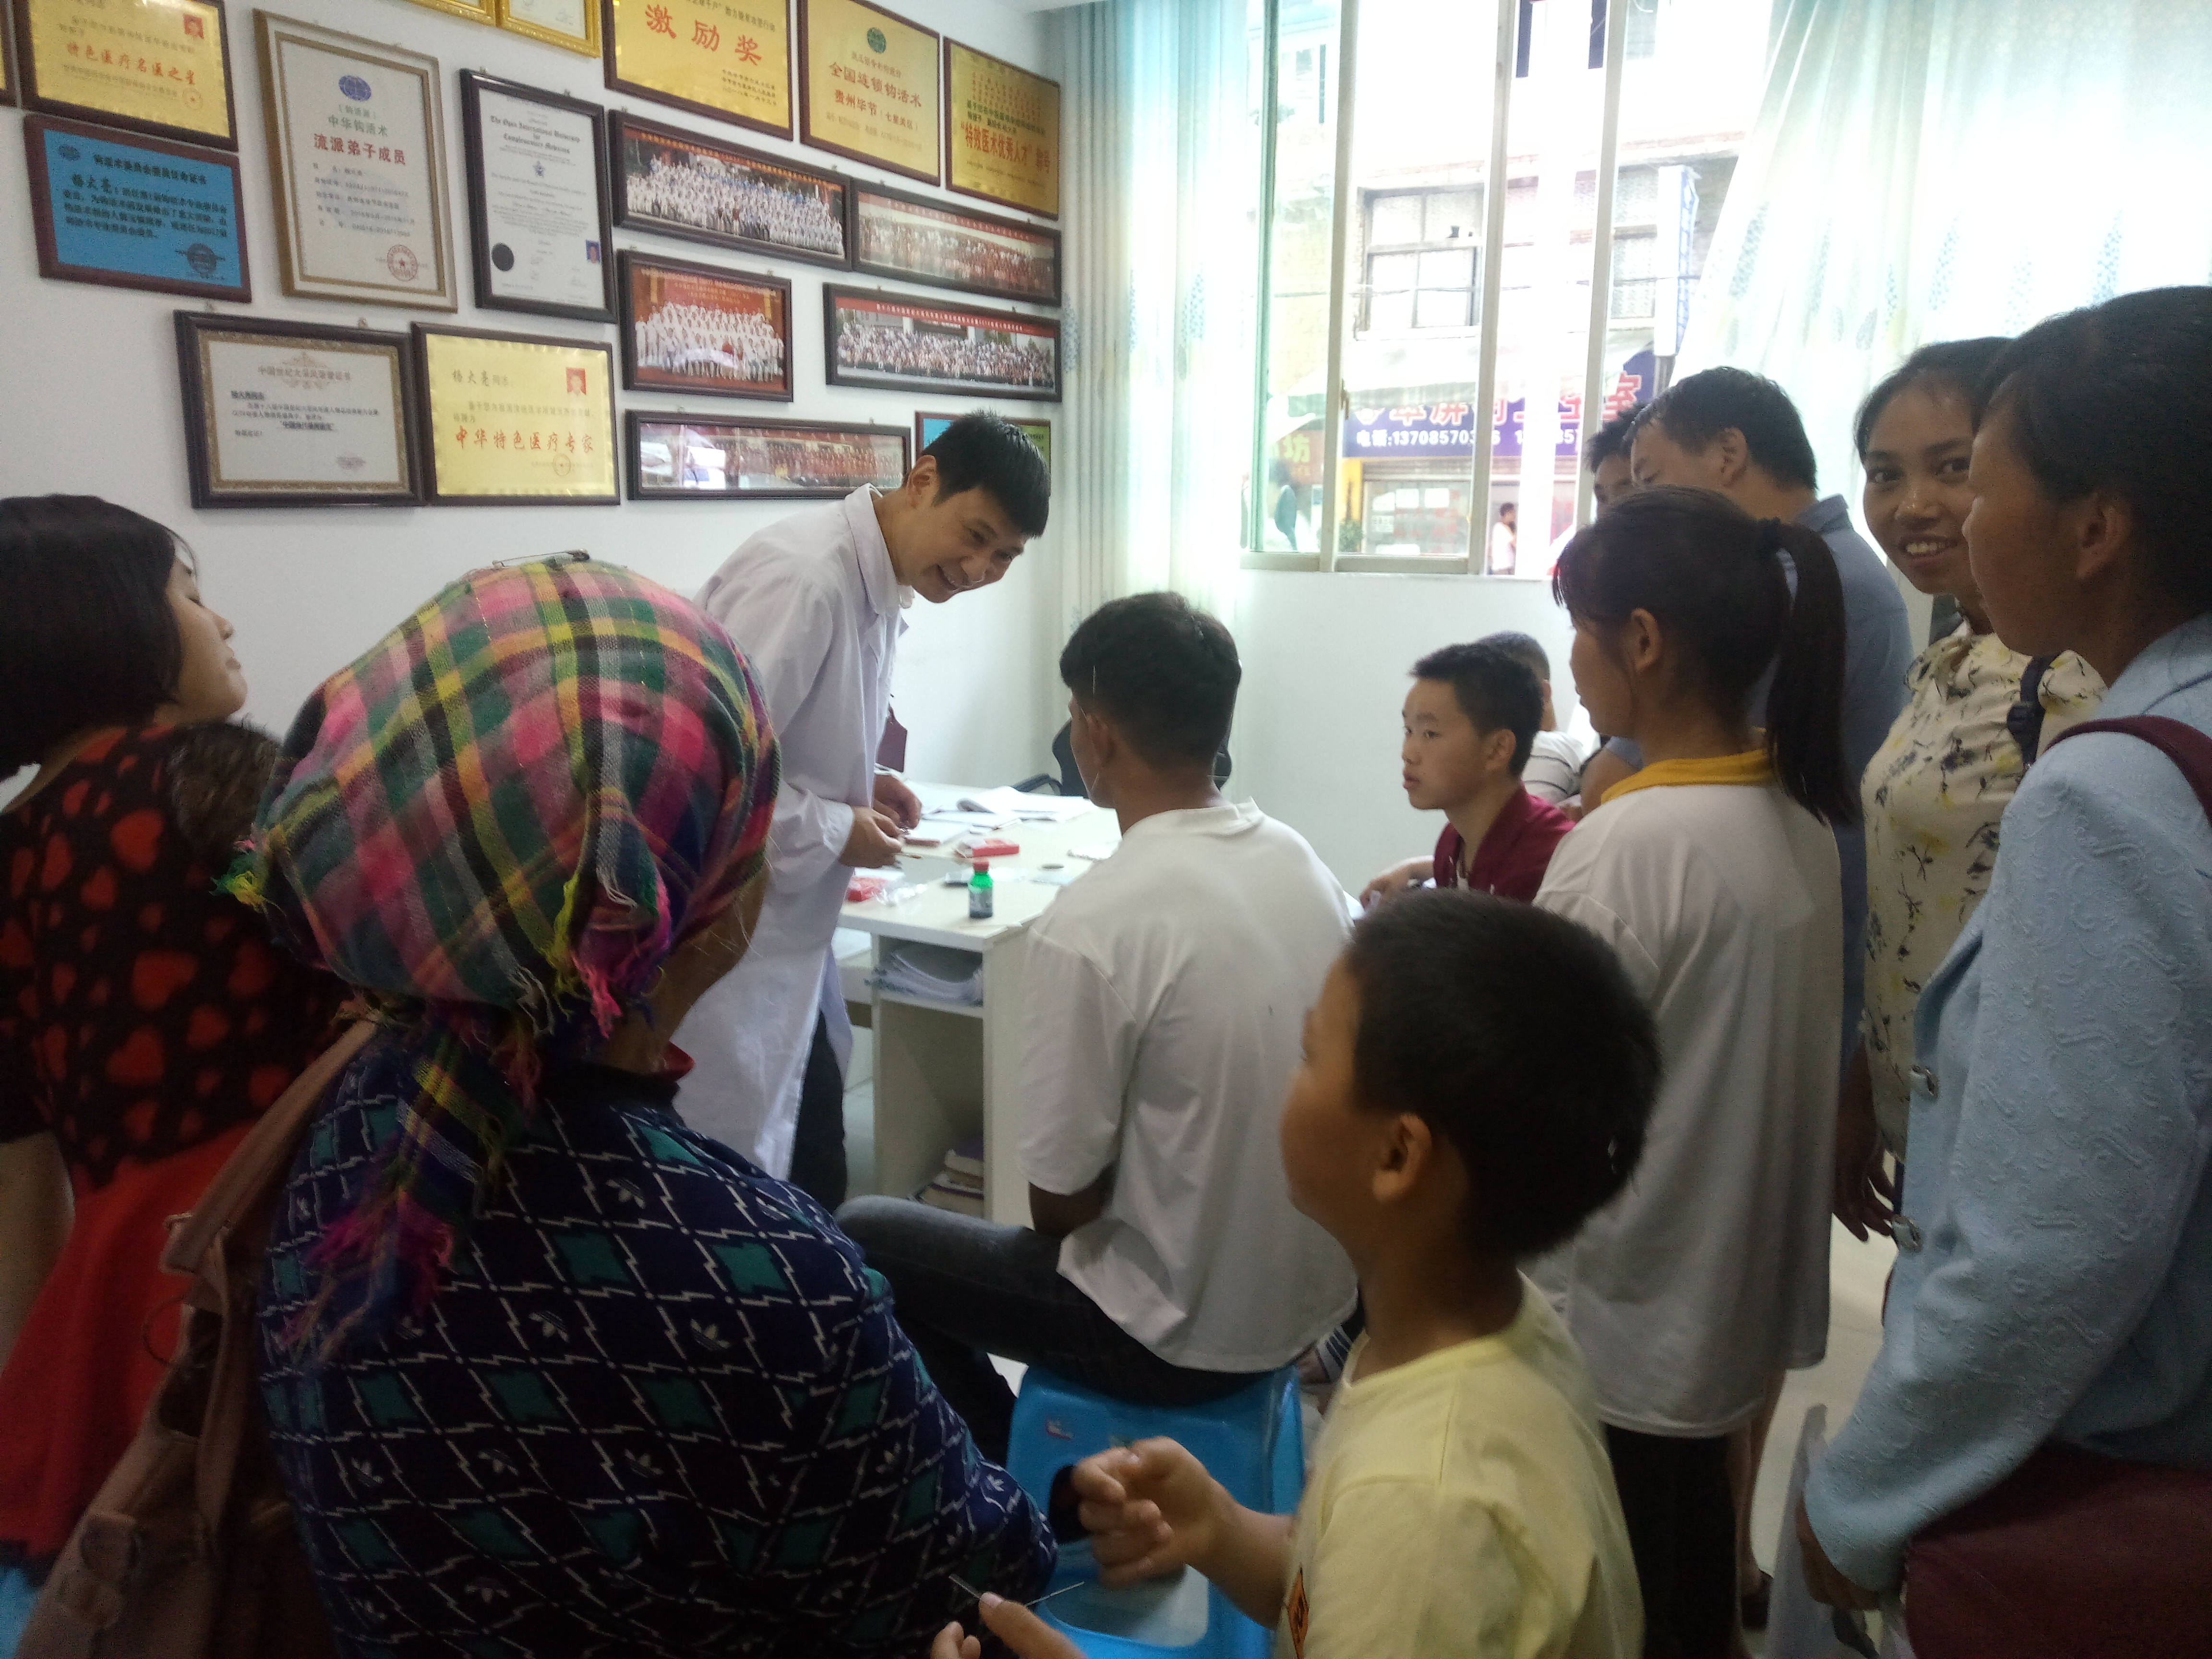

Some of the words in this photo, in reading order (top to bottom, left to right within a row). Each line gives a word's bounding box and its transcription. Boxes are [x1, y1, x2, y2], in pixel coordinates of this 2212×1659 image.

[645, 4, 762, 66] 激励奖
[456, 425, 593, 454] 中华特色医疗专家
